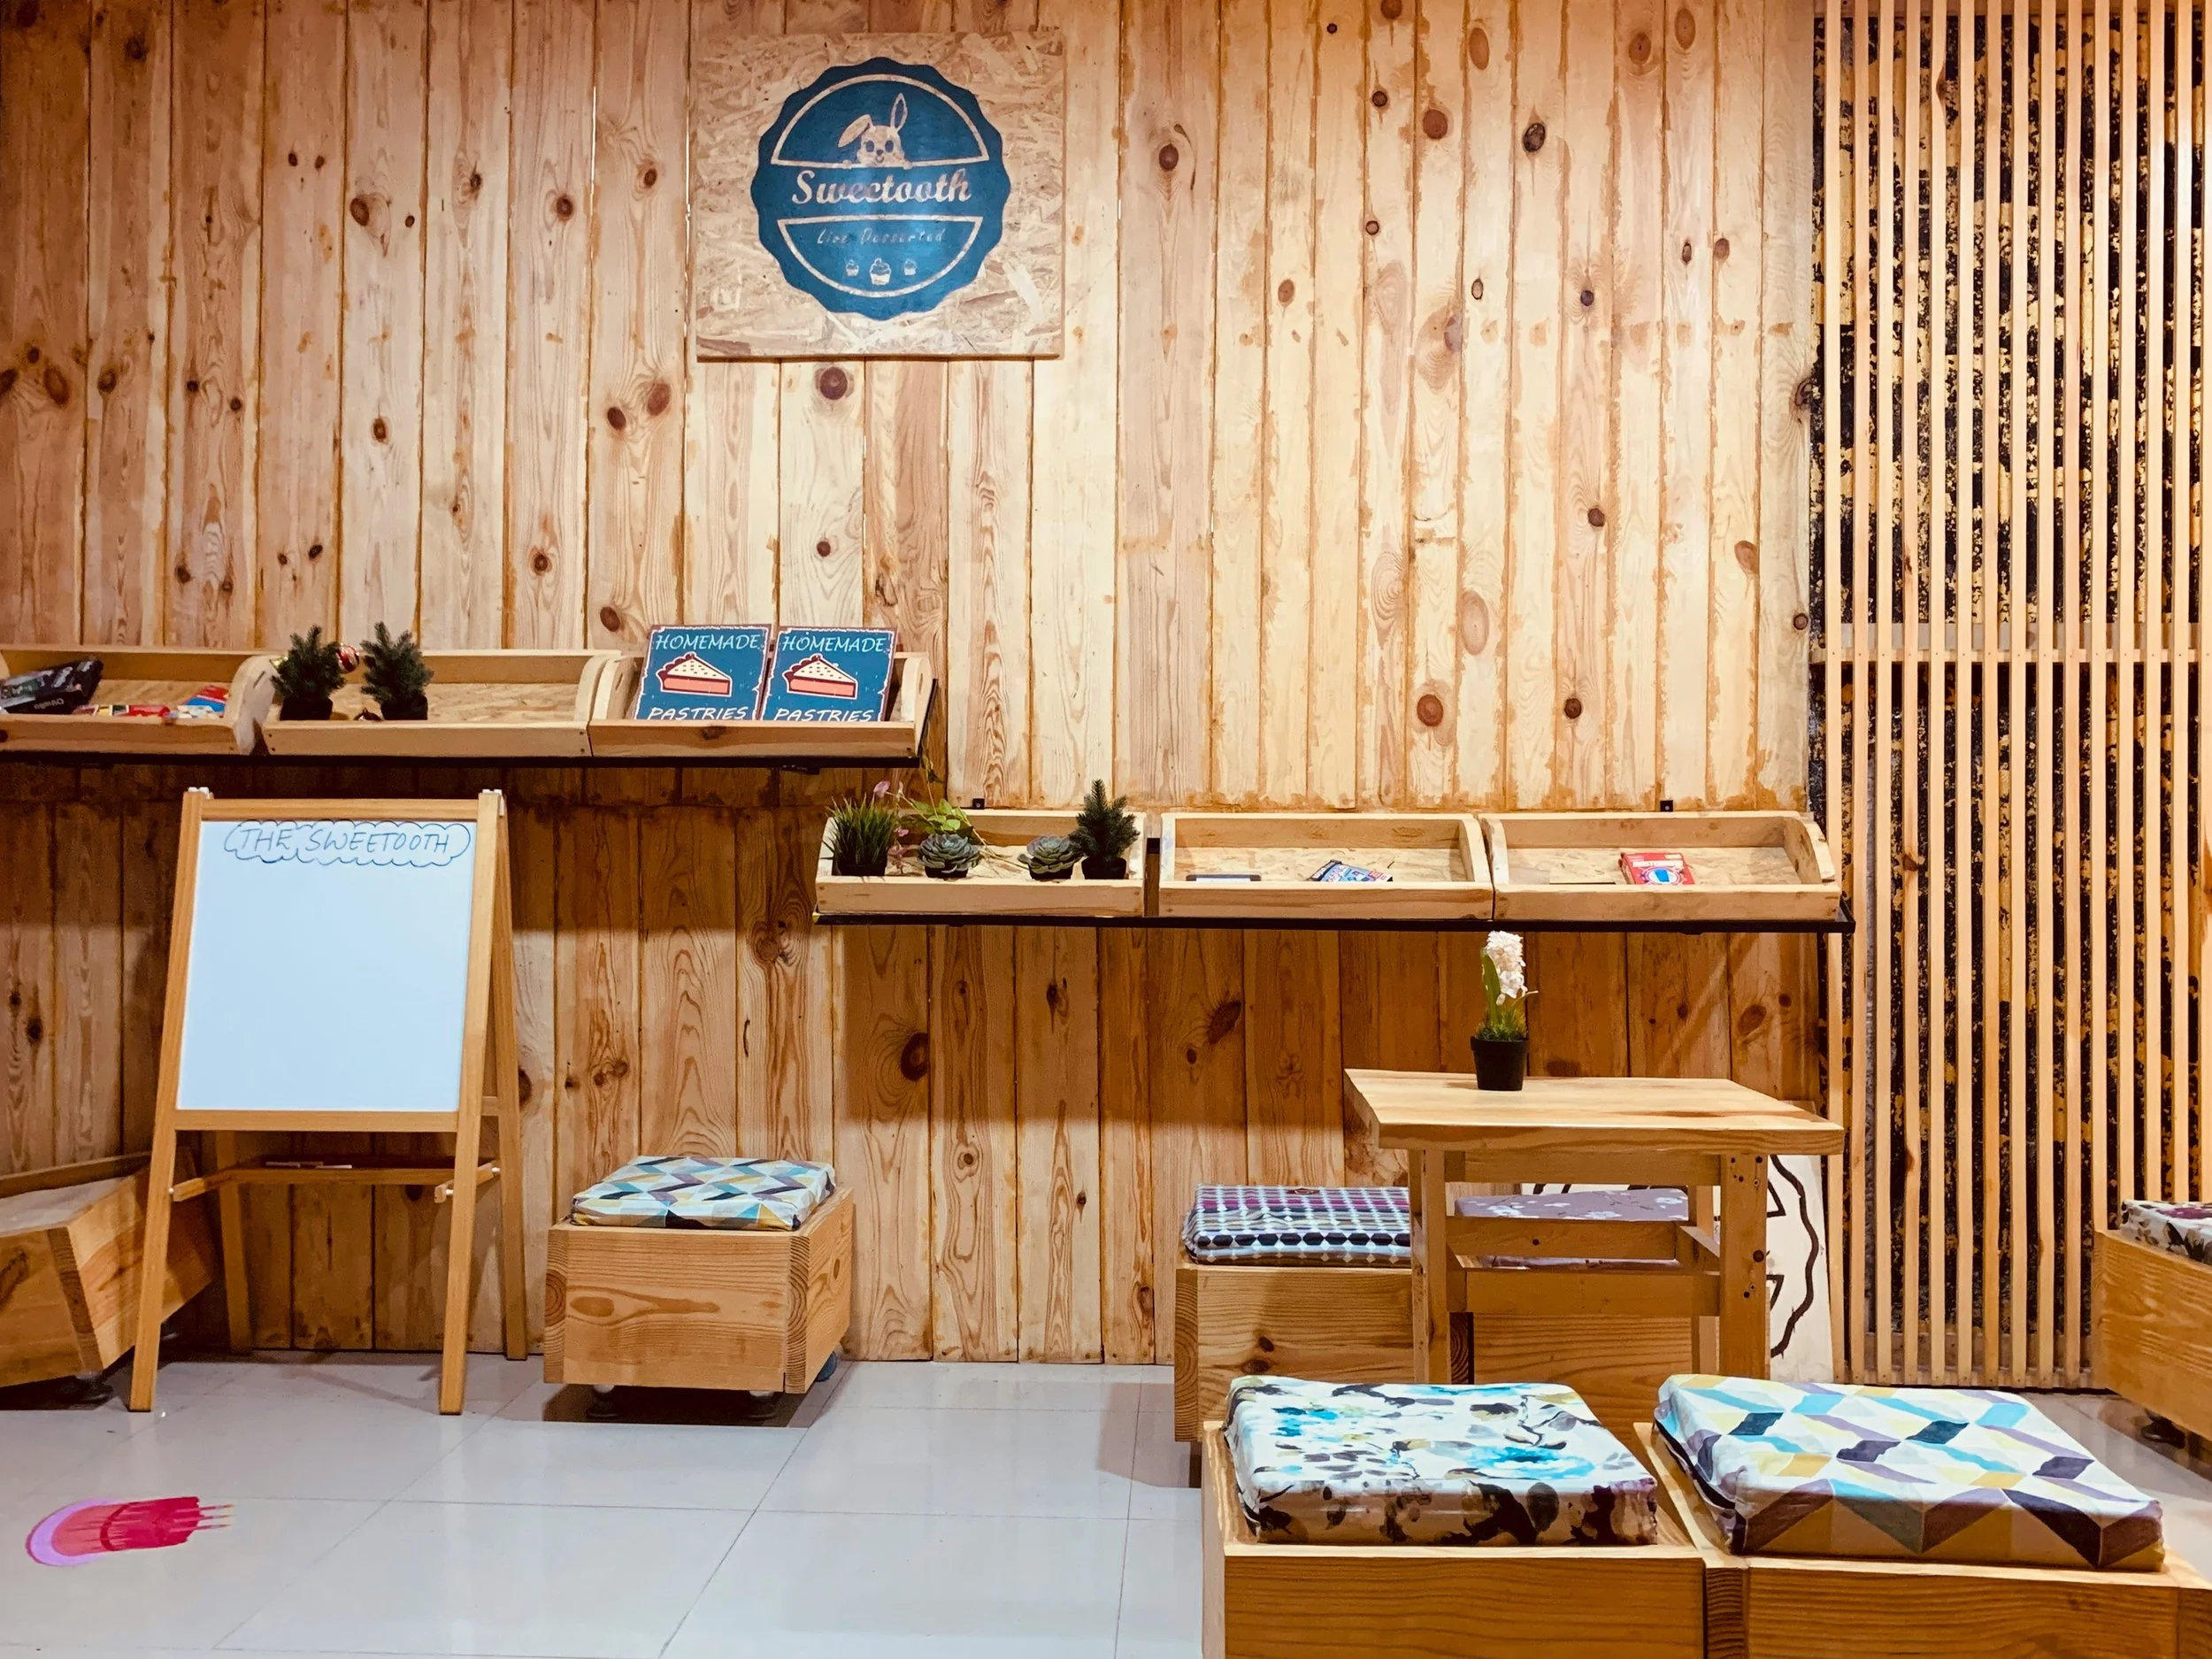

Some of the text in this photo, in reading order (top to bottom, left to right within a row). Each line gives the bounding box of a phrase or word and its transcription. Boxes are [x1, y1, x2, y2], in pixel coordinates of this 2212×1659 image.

[792, 168, 972, 204] Sweetooth
[655, 633, 761, 651] HOMEMADE
[781, 634, 887, 653] HOMEMADE
[648, 706, 749, 721] PASTRIES
[773, 708, 875, 722] PASTRIES
[241, 828, 449, 853] THE SWEETOOTH
